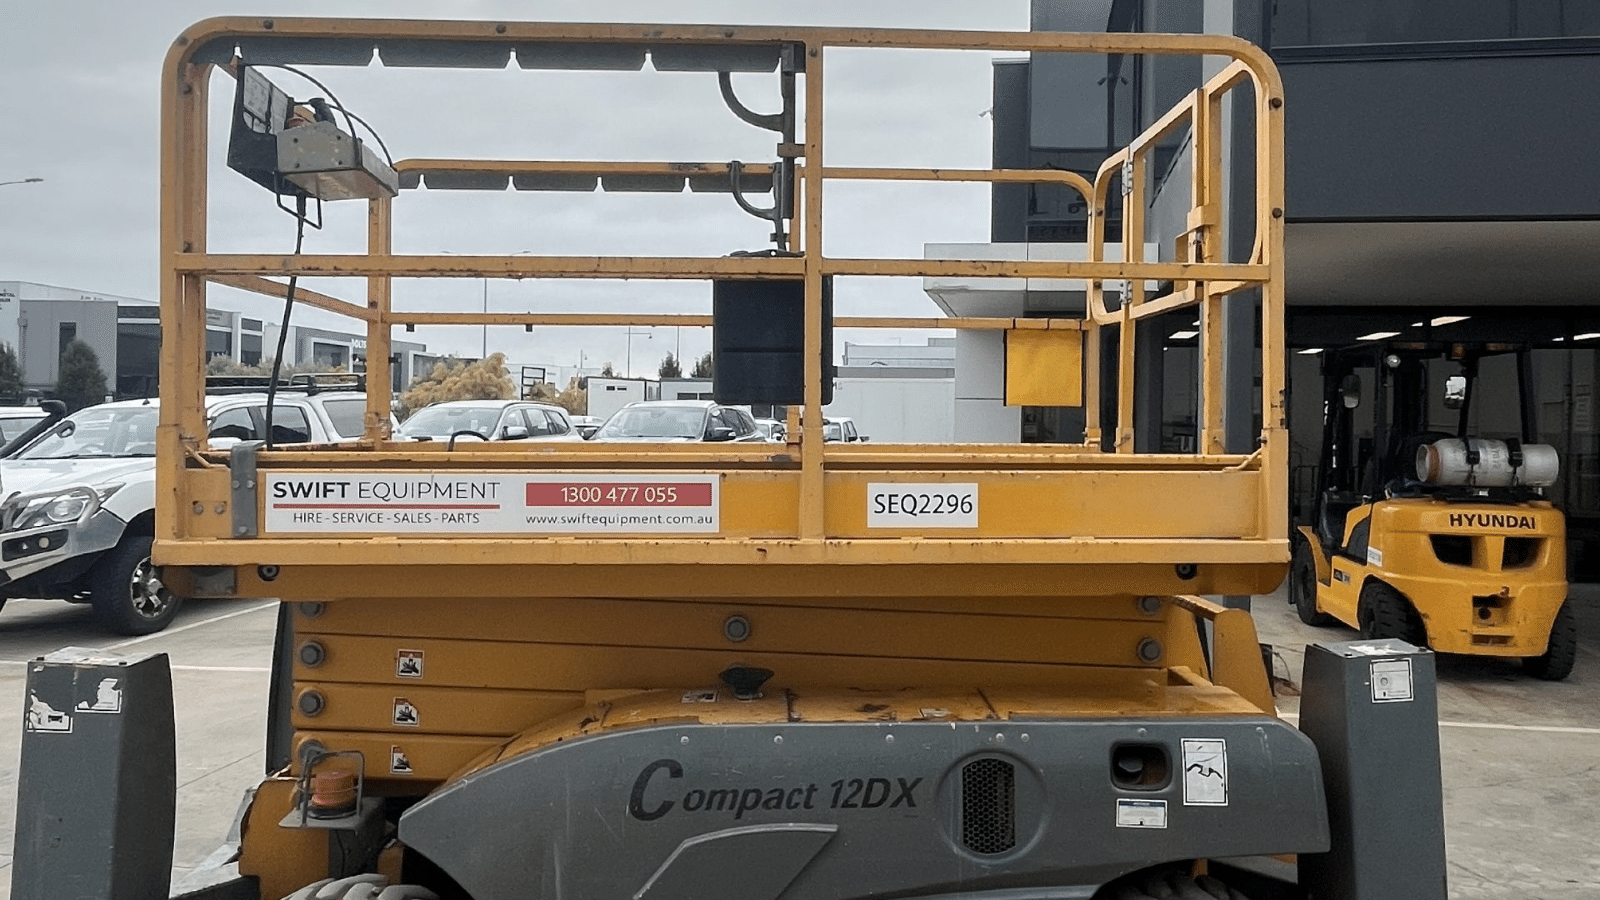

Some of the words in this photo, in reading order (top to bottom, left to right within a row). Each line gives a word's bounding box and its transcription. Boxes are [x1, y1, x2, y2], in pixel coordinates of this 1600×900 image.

[273, 481, 351, 499] SWIFT
[358, 481, 501, 502] EQUIPMENT
[560, 486, 602, 503] 1300
[605, 486, 640, 503] 477
[644, 486, 678, 503] 055
[873, 493, 974, 517] SEQ2296
[525, 513, 713, 527] www.swiftequipment.com.au
[1449, 513, 1536, 530] HYUNDAI
[629, 758, 818, 822] Compact
[829, 776, 924, 809] 12DX
